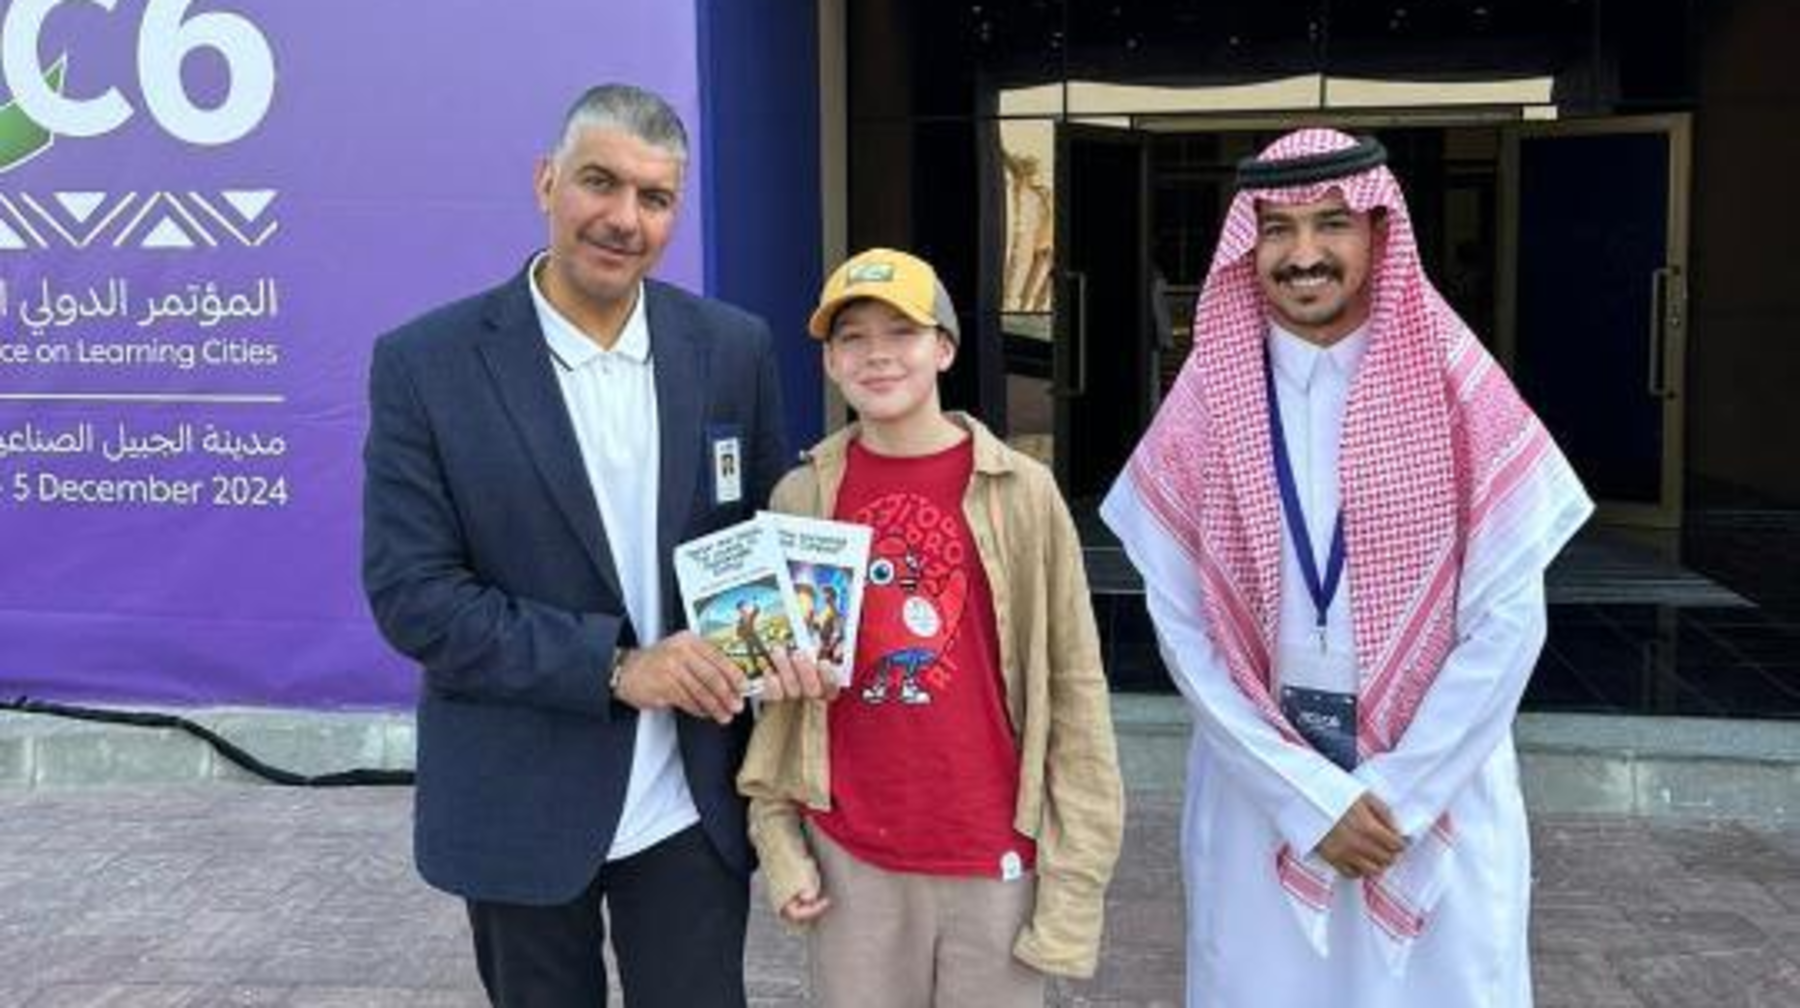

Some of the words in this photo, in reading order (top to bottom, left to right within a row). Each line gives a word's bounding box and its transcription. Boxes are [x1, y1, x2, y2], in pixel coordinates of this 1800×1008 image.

[19, 277, 128, 336] الدولي
[137, 277, 279, 327] المؤتمر
[36, 344, 71, 363] on
[78, 338, 195, 369] Learning
[202, 337, 278, 364] Cities
[103, 421, 194, 461] الجبيل
[202, 423, 287, 460] مدينة
[12, 473, 31, 502] 5
[39, 473, 203, 503] December
[212, 476, 288, 505] 2024
